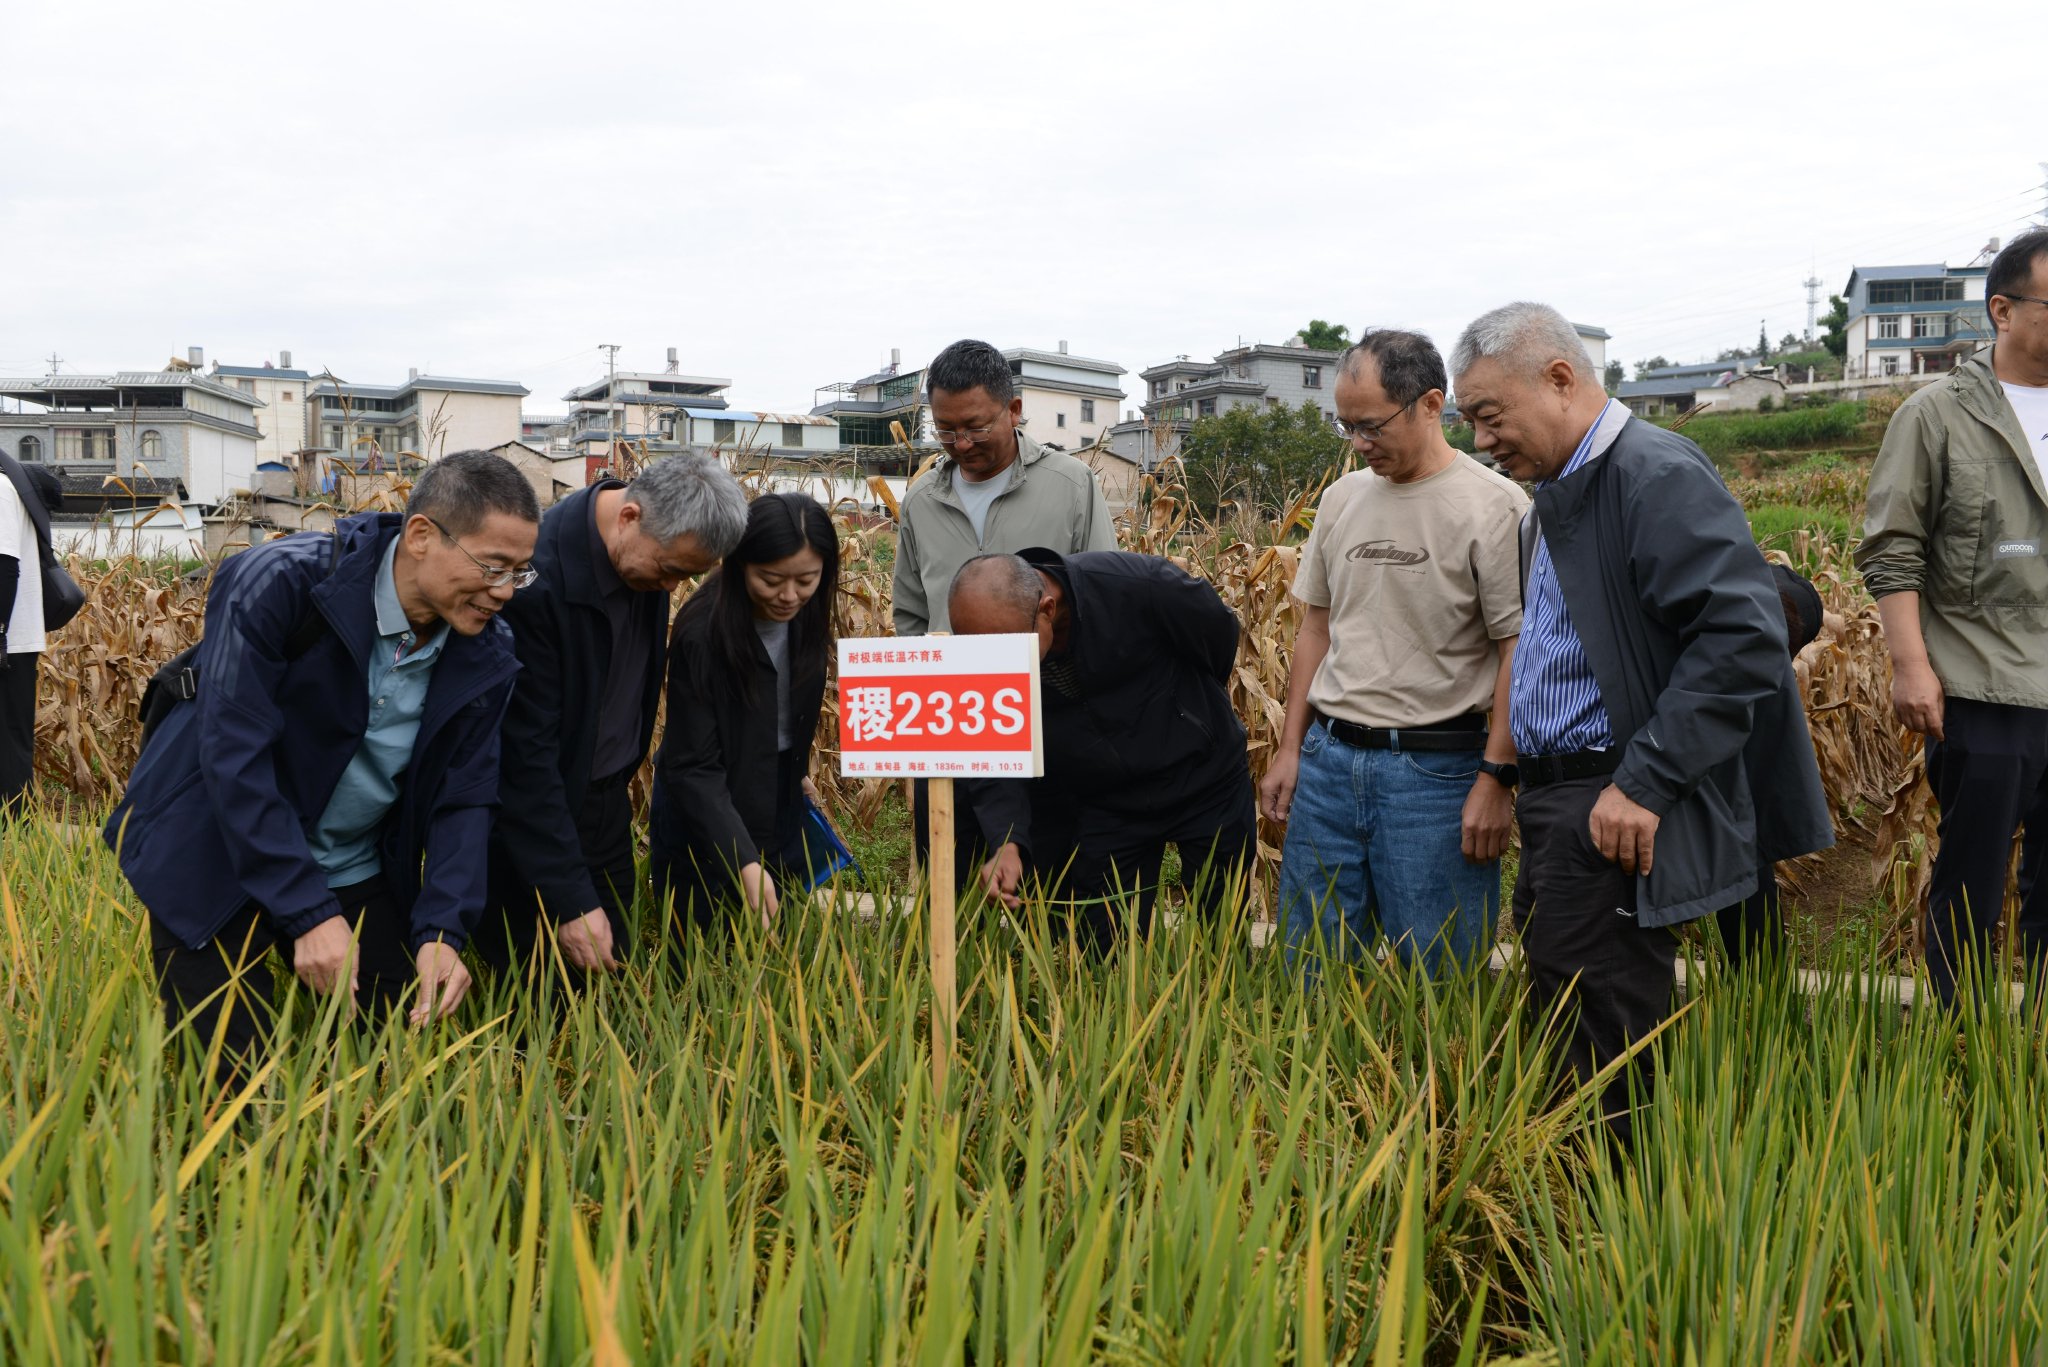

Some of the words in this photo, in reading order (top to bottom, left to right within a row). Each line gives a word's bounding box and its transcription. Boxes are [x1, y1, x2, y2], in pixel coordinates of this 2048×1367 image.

[848, 649, 943, 664] 耐极端低温不育系
[846, 686, 1025, 742] 稷233S
